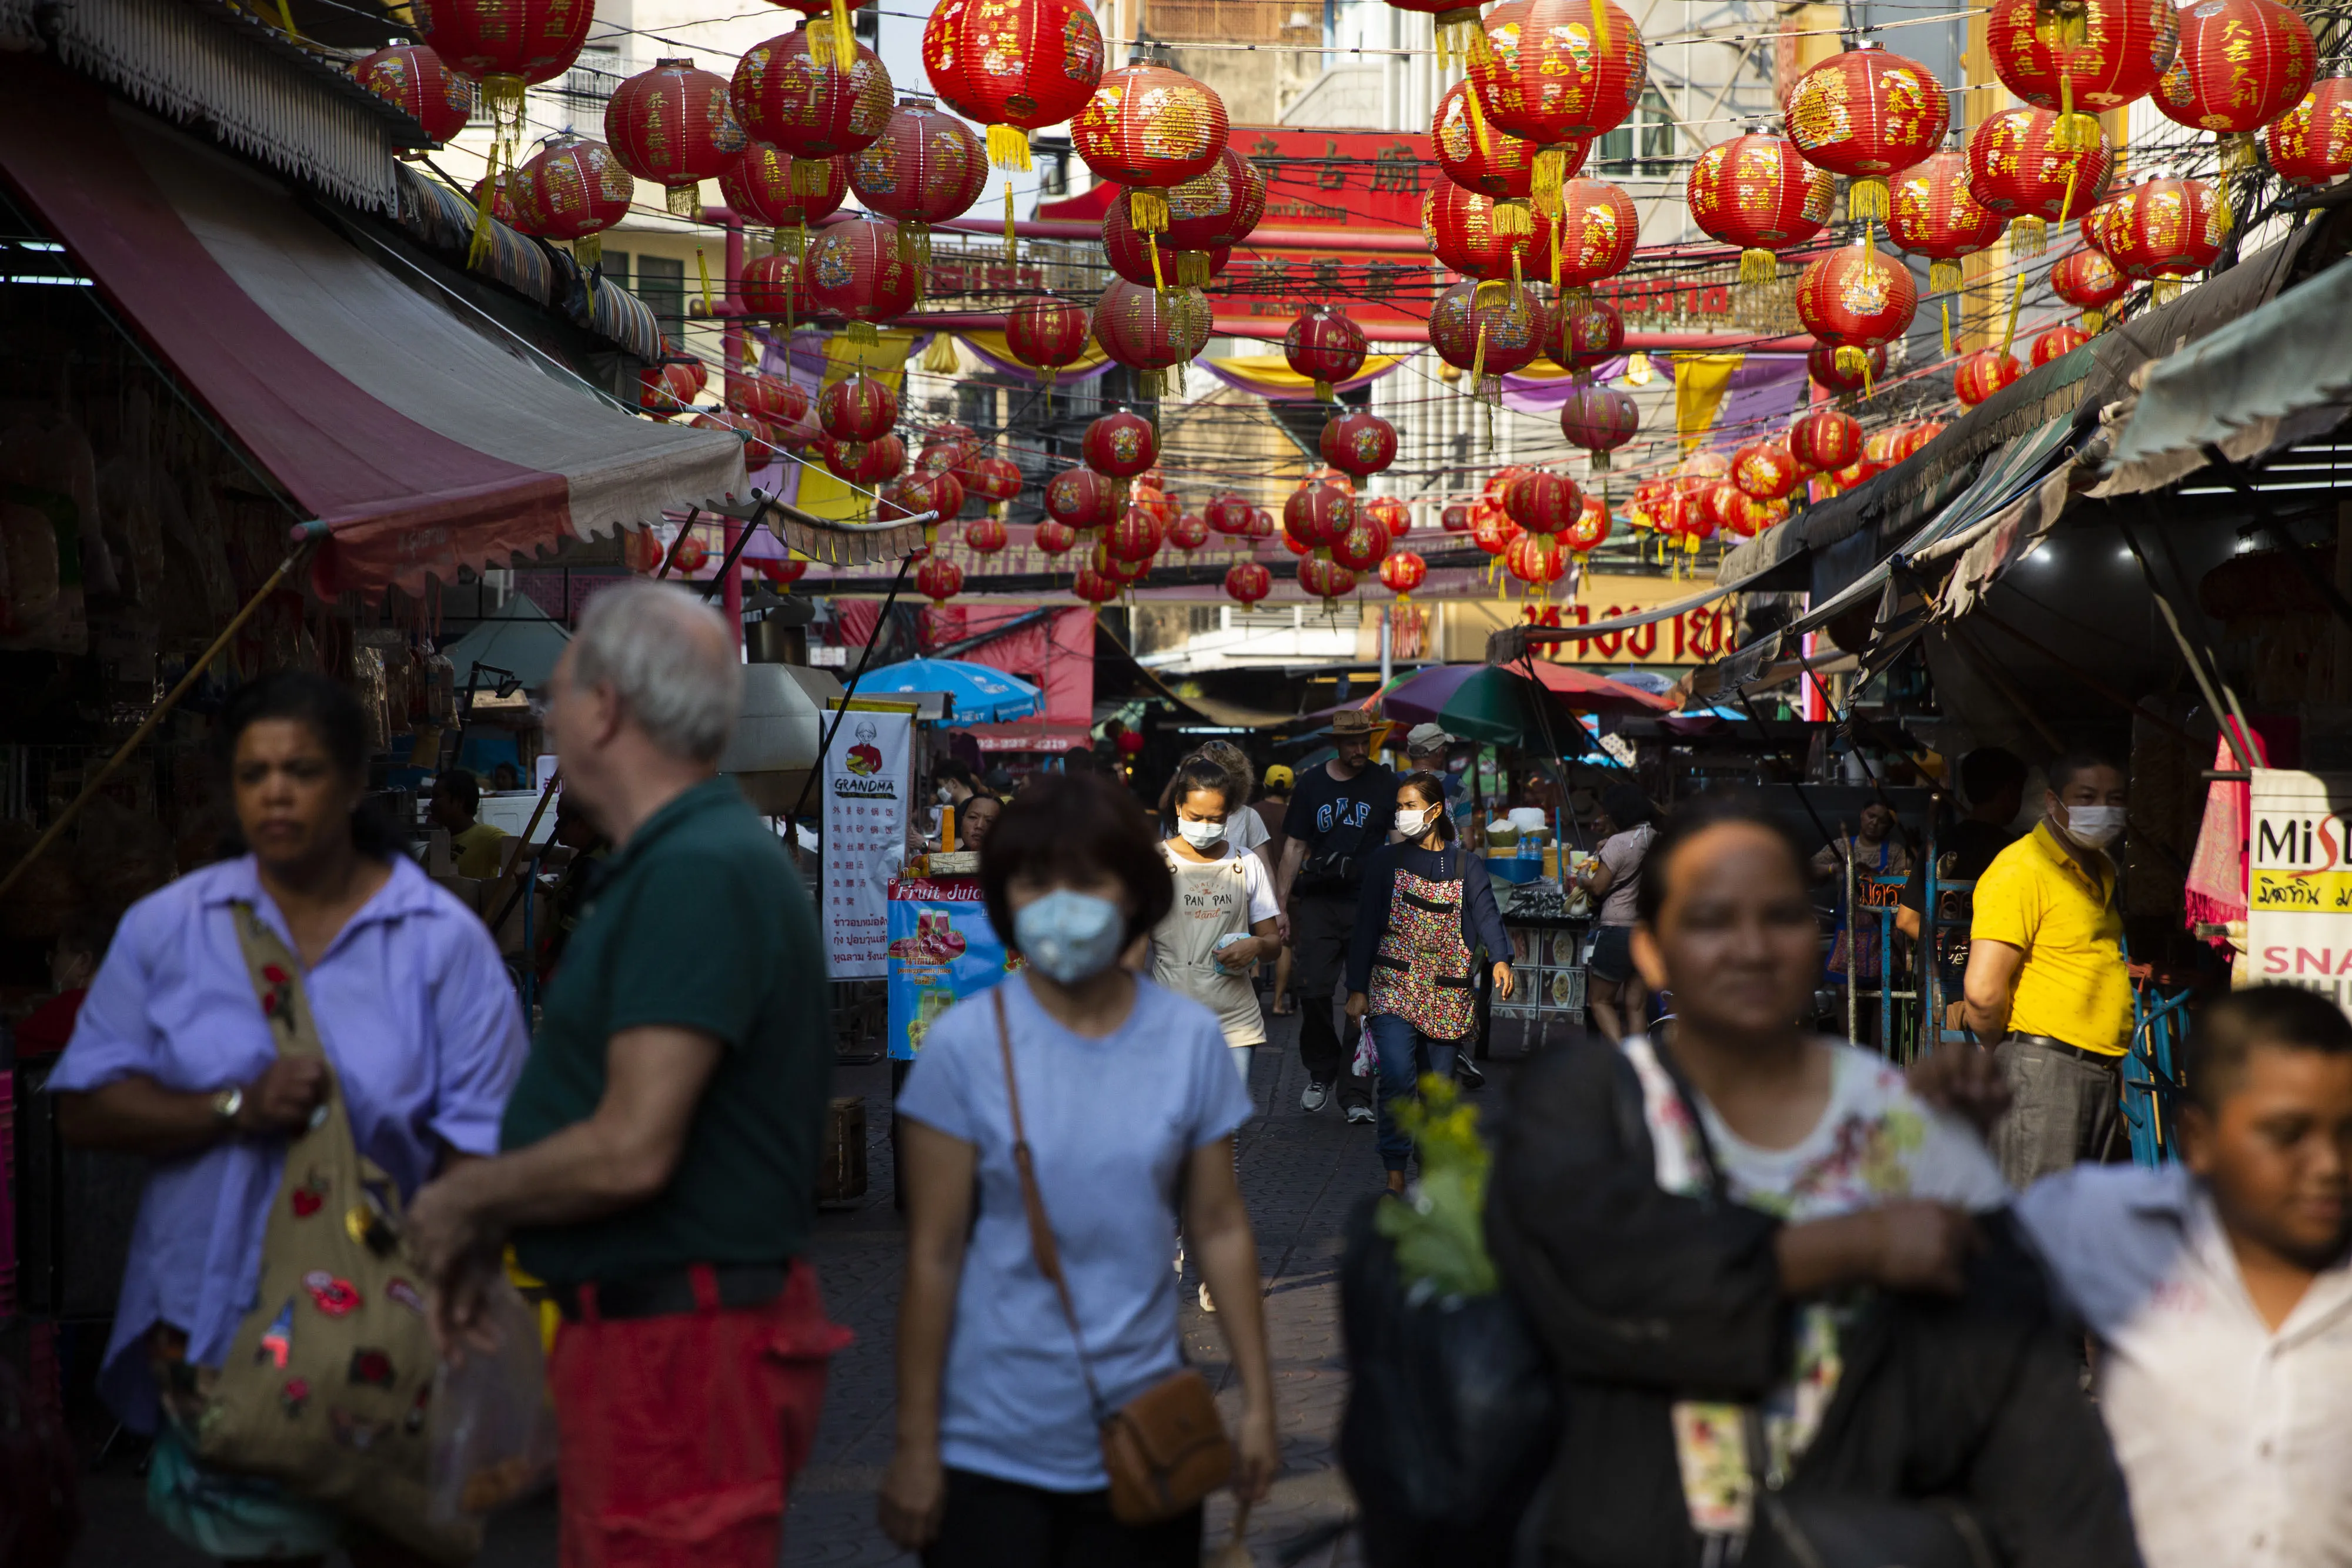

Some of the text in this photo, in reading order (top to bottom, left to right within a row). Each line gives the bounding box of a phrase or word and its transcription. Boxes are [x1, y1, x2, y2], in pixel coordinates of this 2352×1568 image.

[2220, 19, 2259, 108] 大吉大利
[1883, 88, 1923, 146] 恭喜
[1992, 127, 2020, 176] 吉祥
[1581, 224, 1611, 268] 發財
[835, 778, 894, 793] GRANDMA
[1318, 798, 1371, 833] GAP
[897, 884, 940, 900] Fruit
[1190, 882, 1224, 891] QUALITY
[1184, 894, 1231, 906] PAN PAN
[1195, 908, 1220, 920] Land
